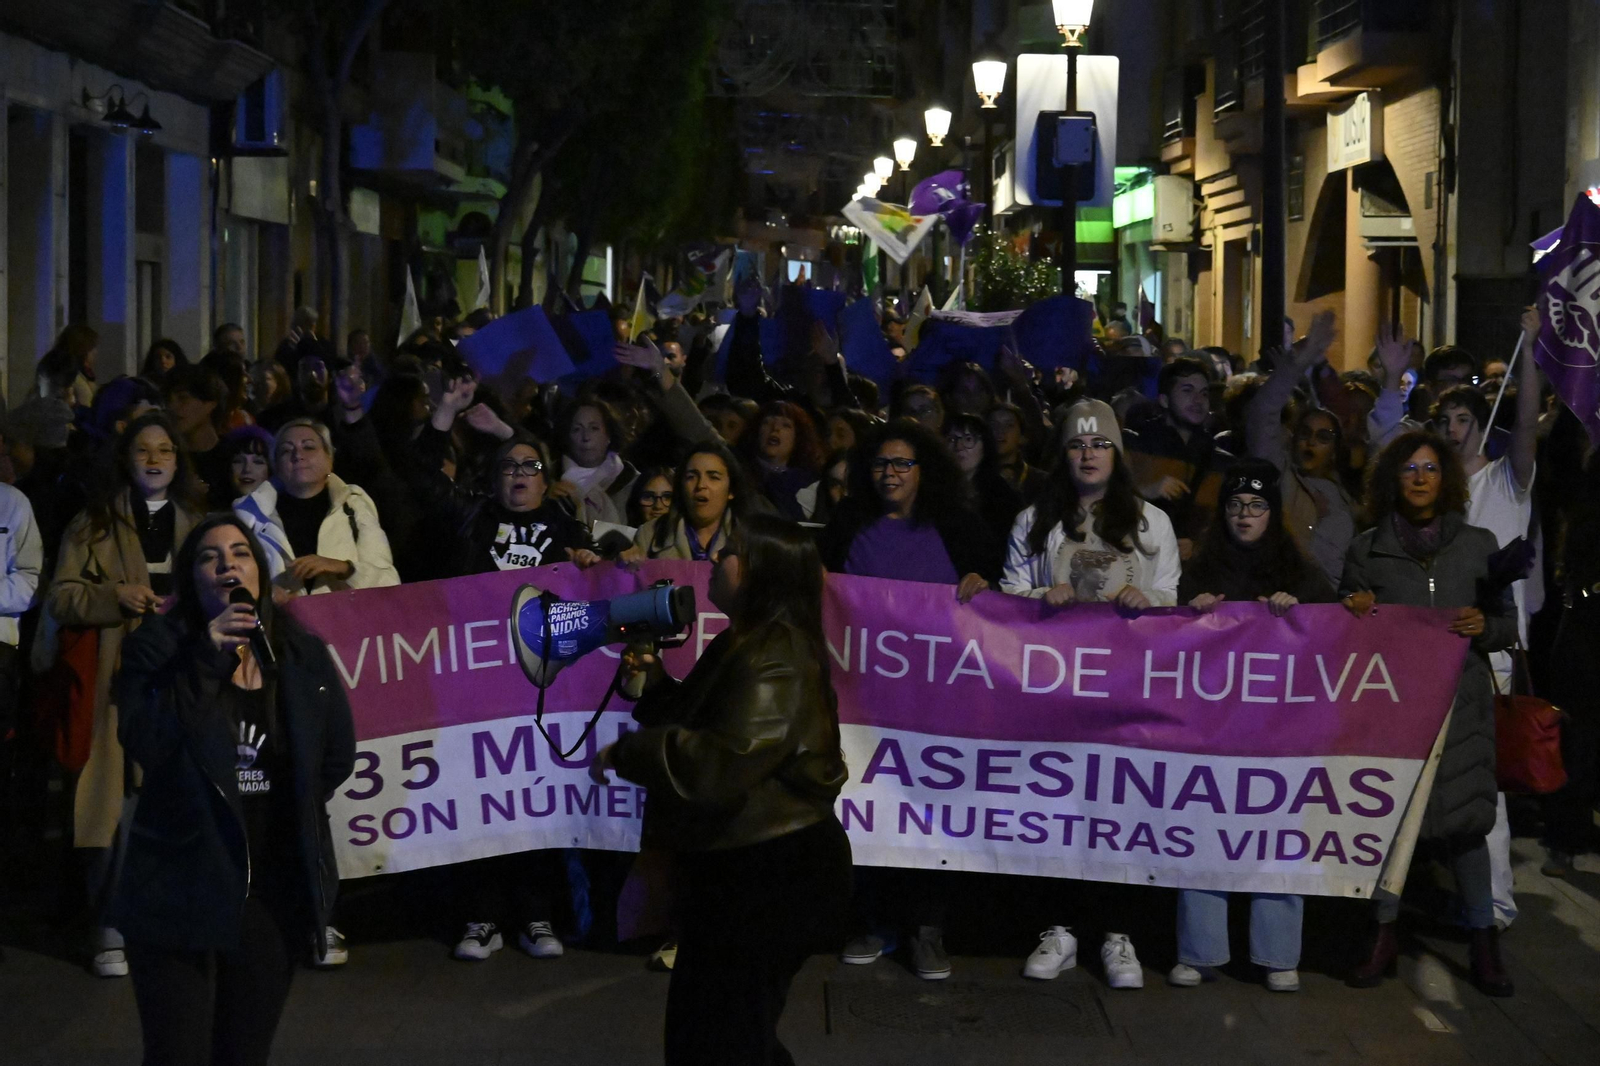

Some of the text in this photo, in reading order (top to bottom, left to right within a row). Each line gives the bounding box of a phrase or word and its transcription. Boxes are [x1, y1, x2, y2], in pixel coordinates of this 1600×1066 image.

[1077, 416, 1097, 434] M
[506, 552, 537, 567] 1334
[551, 609, 586, 623] PARAMOS
[326, 616, 518, 690] VIMIE
[1021, 644, 1112, 698] DE
[1143, 649, 1400, 703] HUELVA
[237, 770, 264, 781] ERES
[861, 738, 1395, 818] ASESINADAS
[238, 780, 270, 792] NADAS
[348, 799, 458, 847] SON
[898, 802, 1195, 858] NUESTRAS
[1217, 829, 1383, 867] VIDAS
